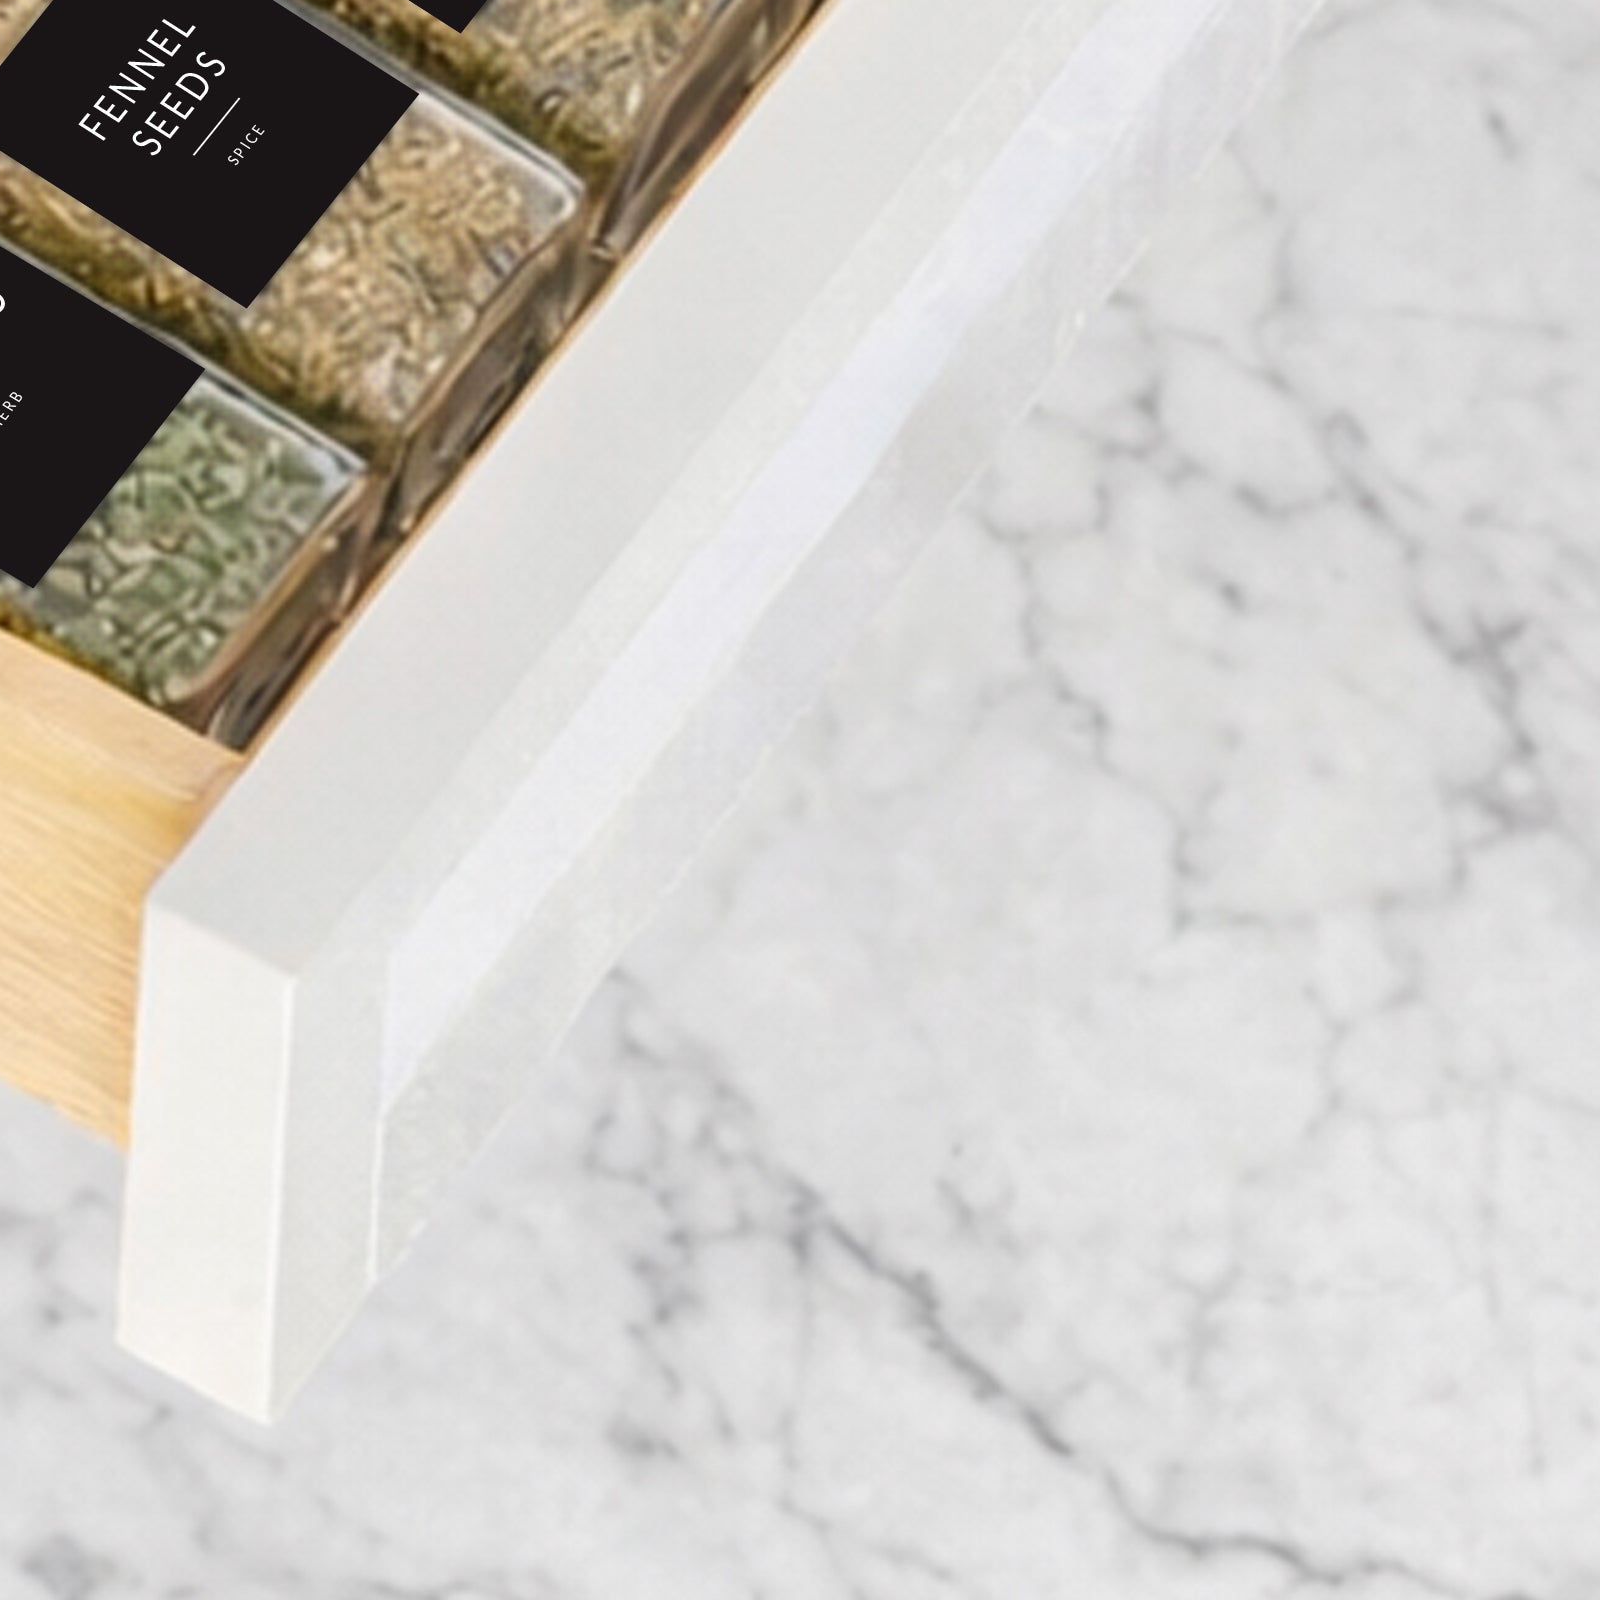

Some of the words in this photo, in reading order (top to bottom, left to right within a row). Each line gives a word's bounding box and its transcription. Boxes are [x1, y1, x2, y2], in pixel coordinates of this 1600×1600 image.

[78, 19, 196, 141] FENNEL
[132, 52, 225, 156] SEEDS
[228, 125, 265, 165] SPICE
